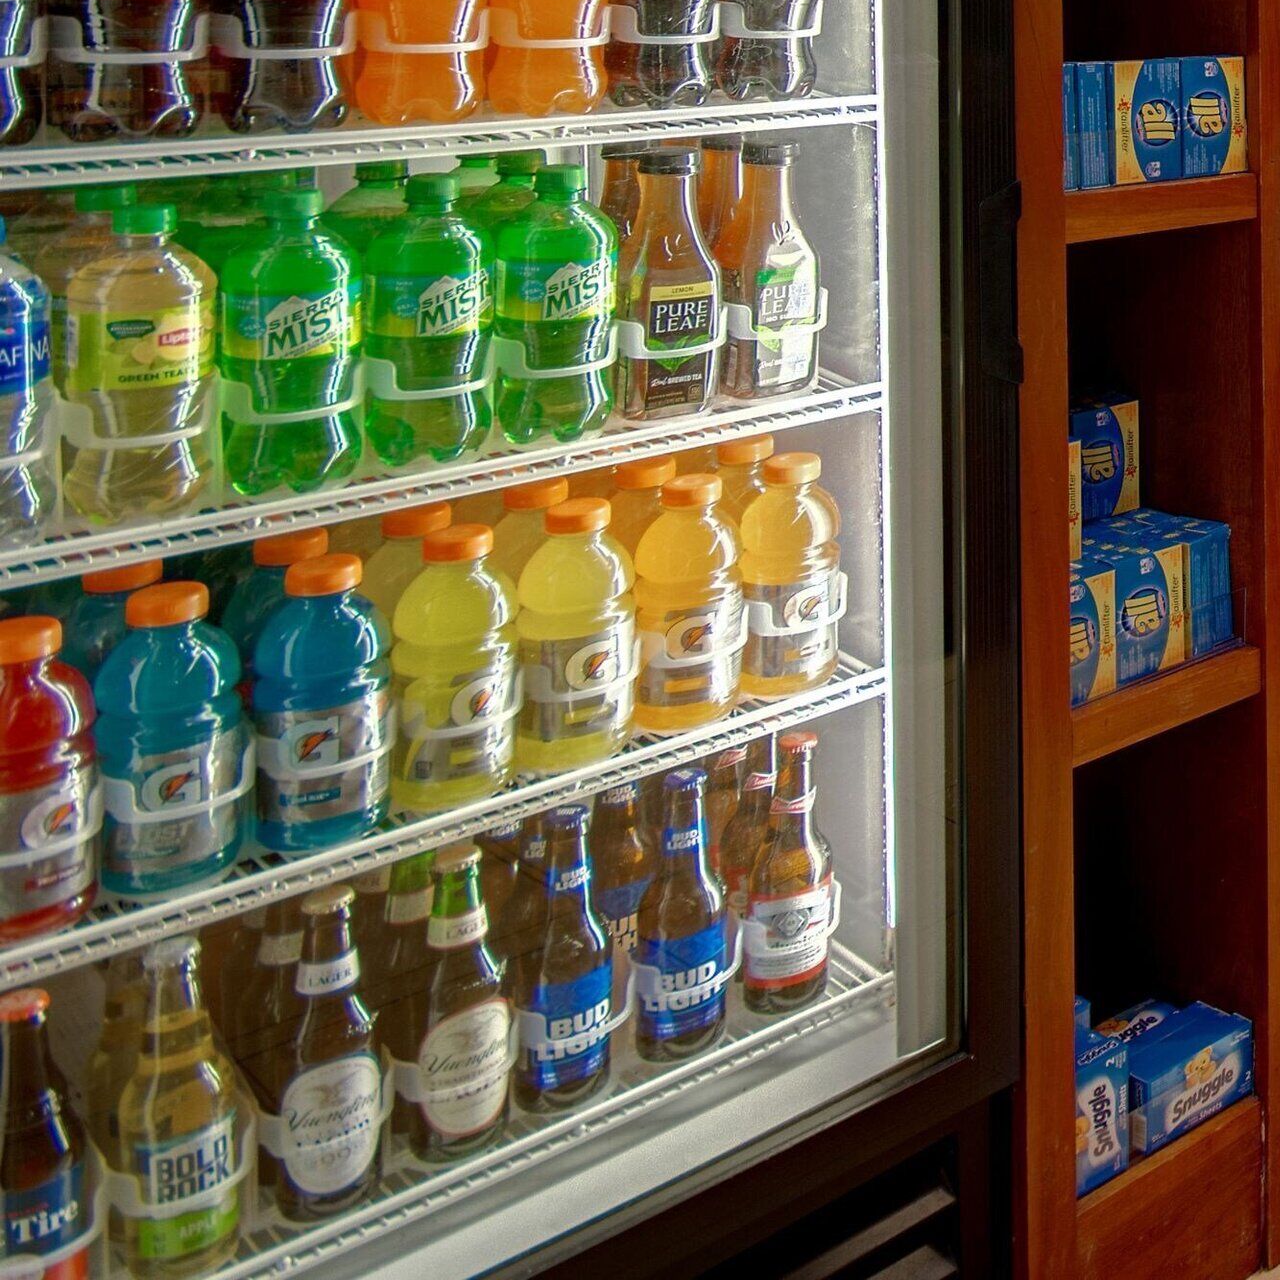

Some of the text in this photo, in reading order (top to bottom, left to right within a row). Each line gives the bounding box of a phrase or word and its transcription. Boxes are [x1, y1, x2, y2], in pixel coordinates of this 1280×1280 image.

[1190, 97, 1224, 135] all
[421, 269, 488, 310] SIERRA
[545, 264, 609, 320] MIST
[547, 257, 609, 294] SIERRA
[671, 286, 694, 294] LEMON
[268, 288, 344, 331] SIERRA
[419, 276, 488, 334] MIST
[655, 314, 706, 333] LEAF
[656, 299, 709, 319] PURE
[266, 301, 344, 358] MIST
[118, 369, 183, 384] GREEN TEA
[1125, 593, 1162, 636] all
[666, 836, 703, 851] LIGHT
[671, 829, 699, 841] BUD
[561, 865, 588, 881] BUD
[308, 969, 352, 988] LAGER
[661, 961, 717, 991] BUD
[551, 999, 609, 1038] BUD
[1172, 1068, 1235, 1123] Snuggle
[1088, 1081, 1114, 1157] Snuggle
[157, 1135, 228, 1184] BOLD
[157, 1154, 230, 1205] ROCK
[12, 1200, 79, 1245] Tire
